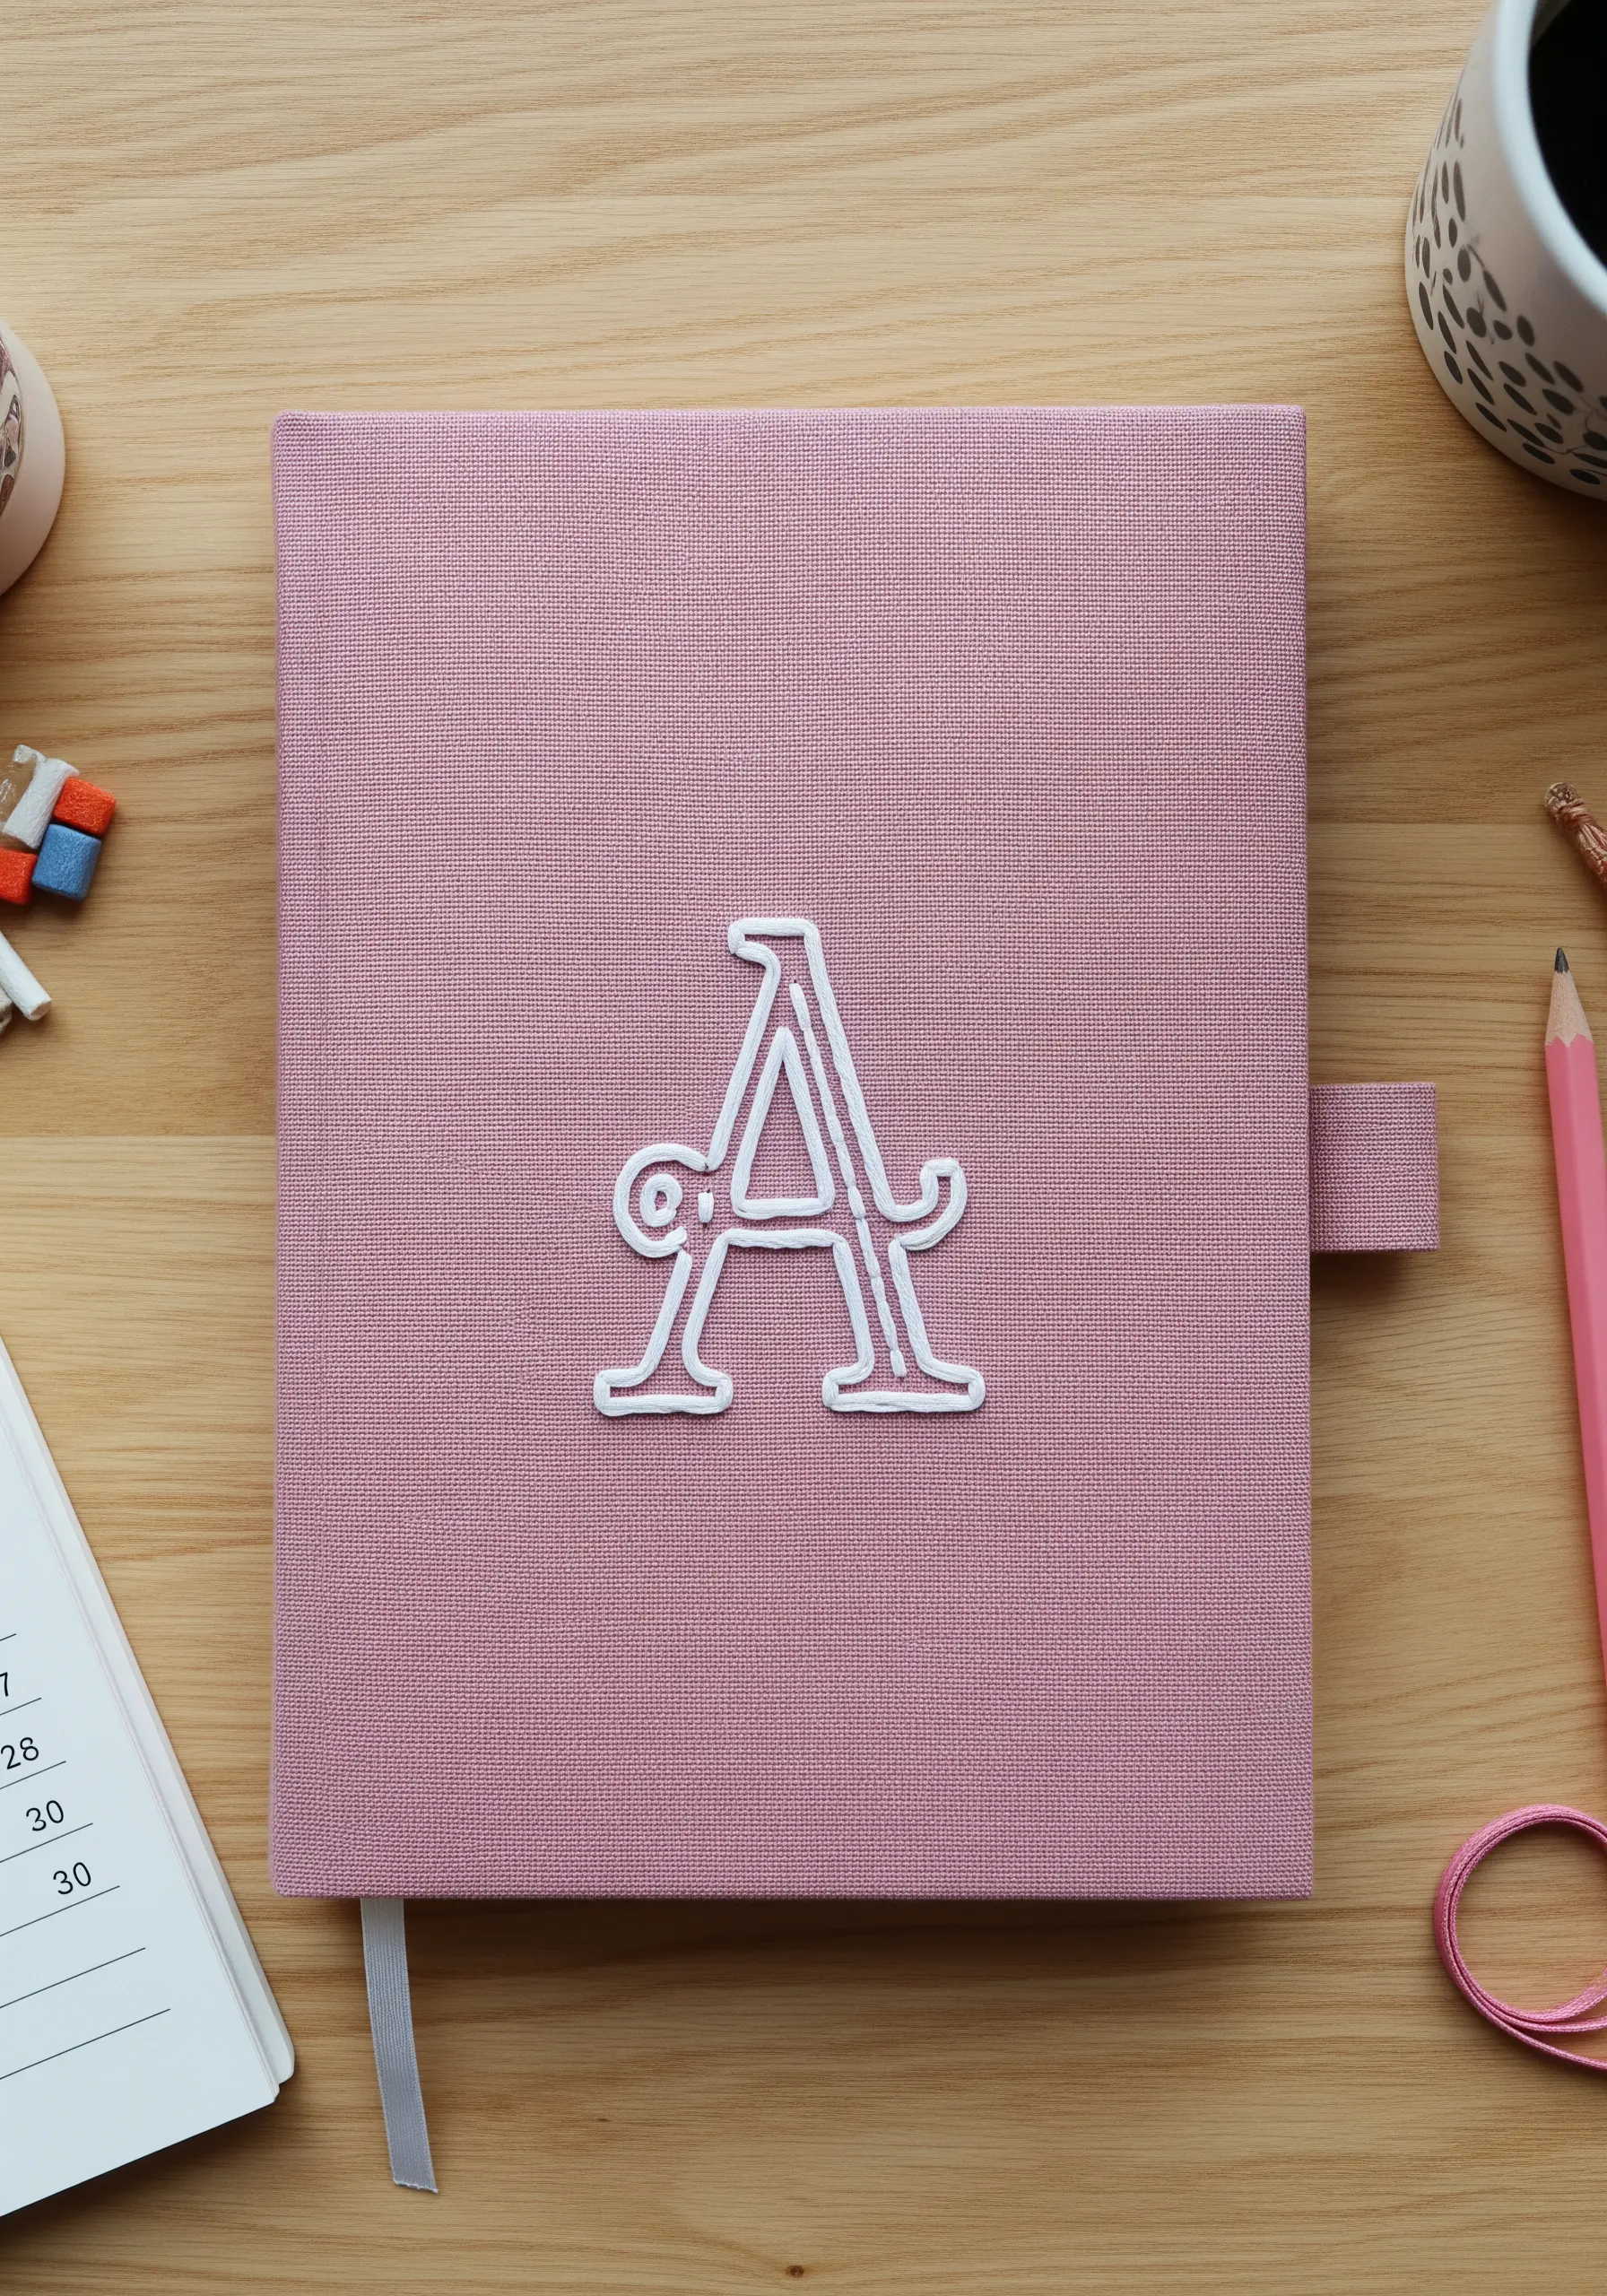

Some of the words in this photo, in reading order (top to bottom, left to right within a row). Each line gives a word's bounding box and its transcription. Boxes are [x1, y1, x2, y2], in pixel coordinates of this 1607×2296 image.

[594, 918, 986, 1416] A
[0, 1736, 39, 1770] 28
[25, 1799, 65, 1832] 30
[53, 1861, 91, 1895] 30
